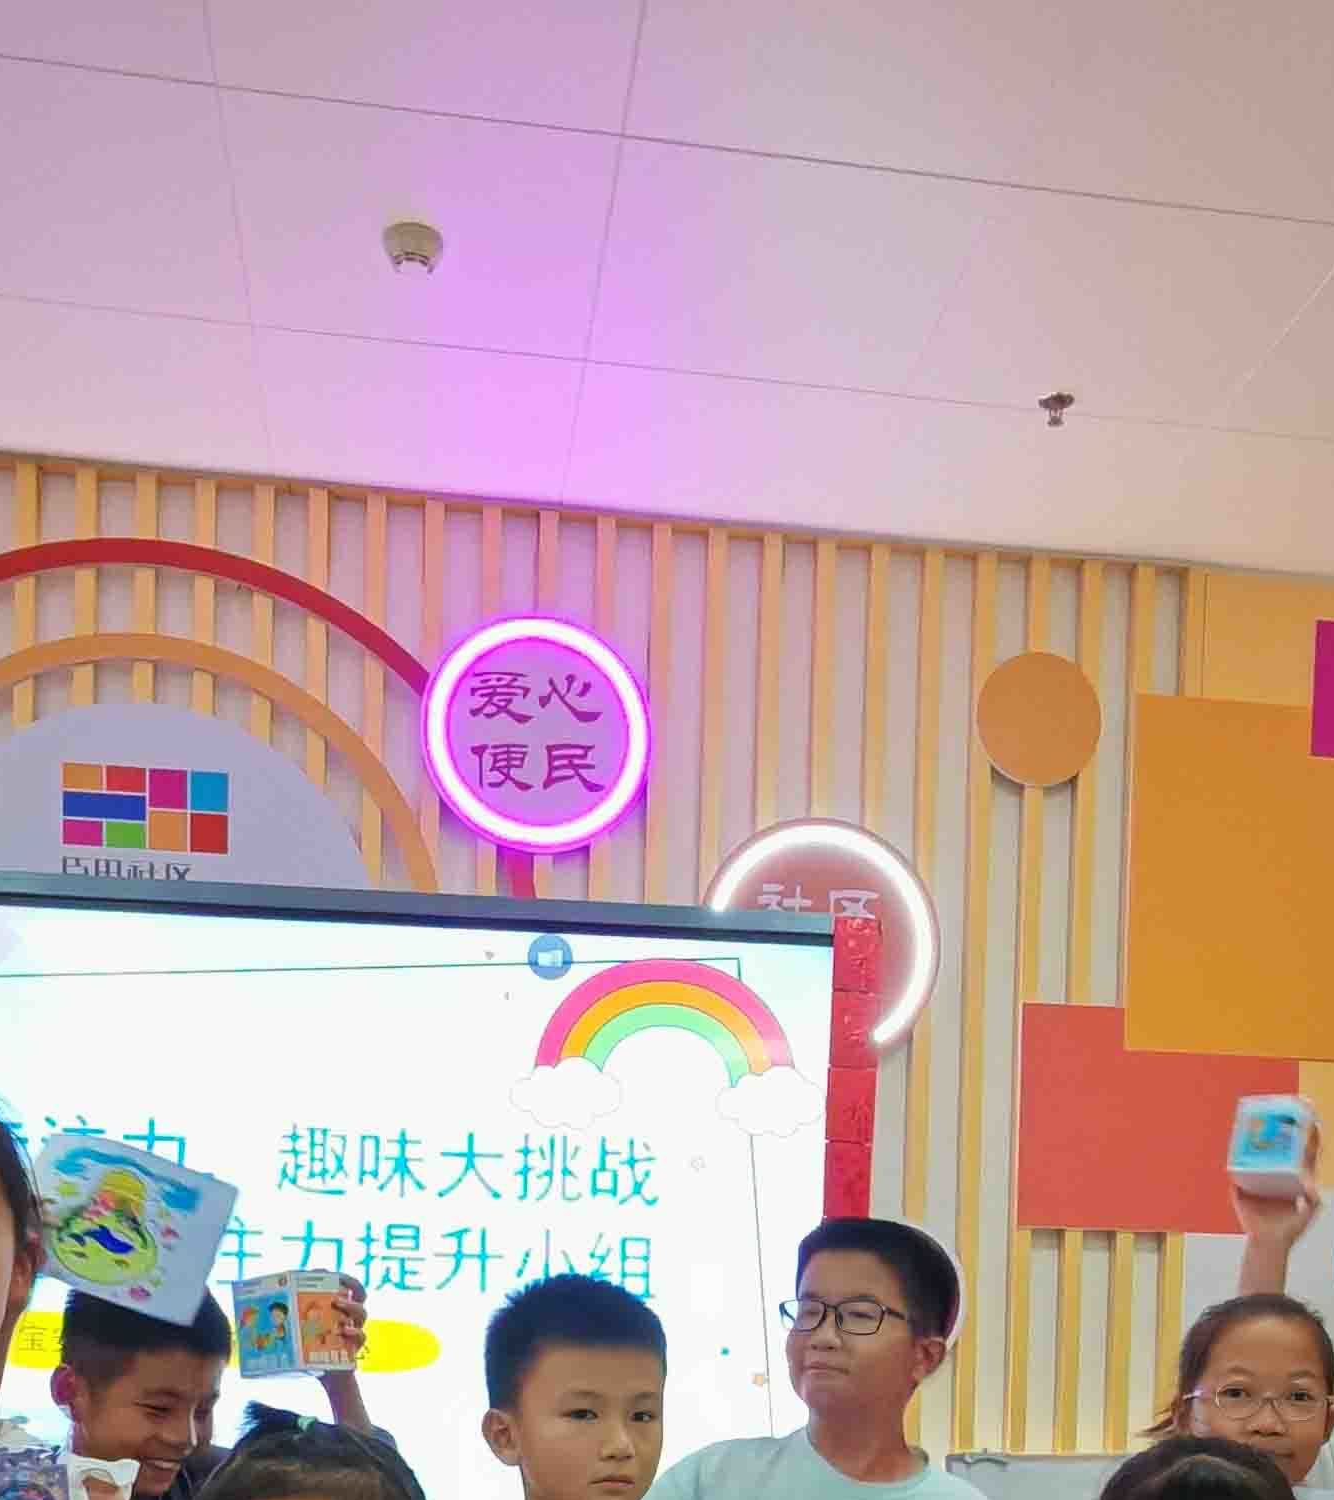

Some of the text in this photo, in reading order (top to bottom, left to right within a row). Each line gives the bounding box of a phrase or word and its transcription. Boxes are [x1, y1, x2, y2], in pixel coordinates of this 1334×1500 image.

[468, 671, 603, 723] 爱心
[469, 742, 605, 792] 便民
[277, 1122, 660, 1206] 趣味大挑战
